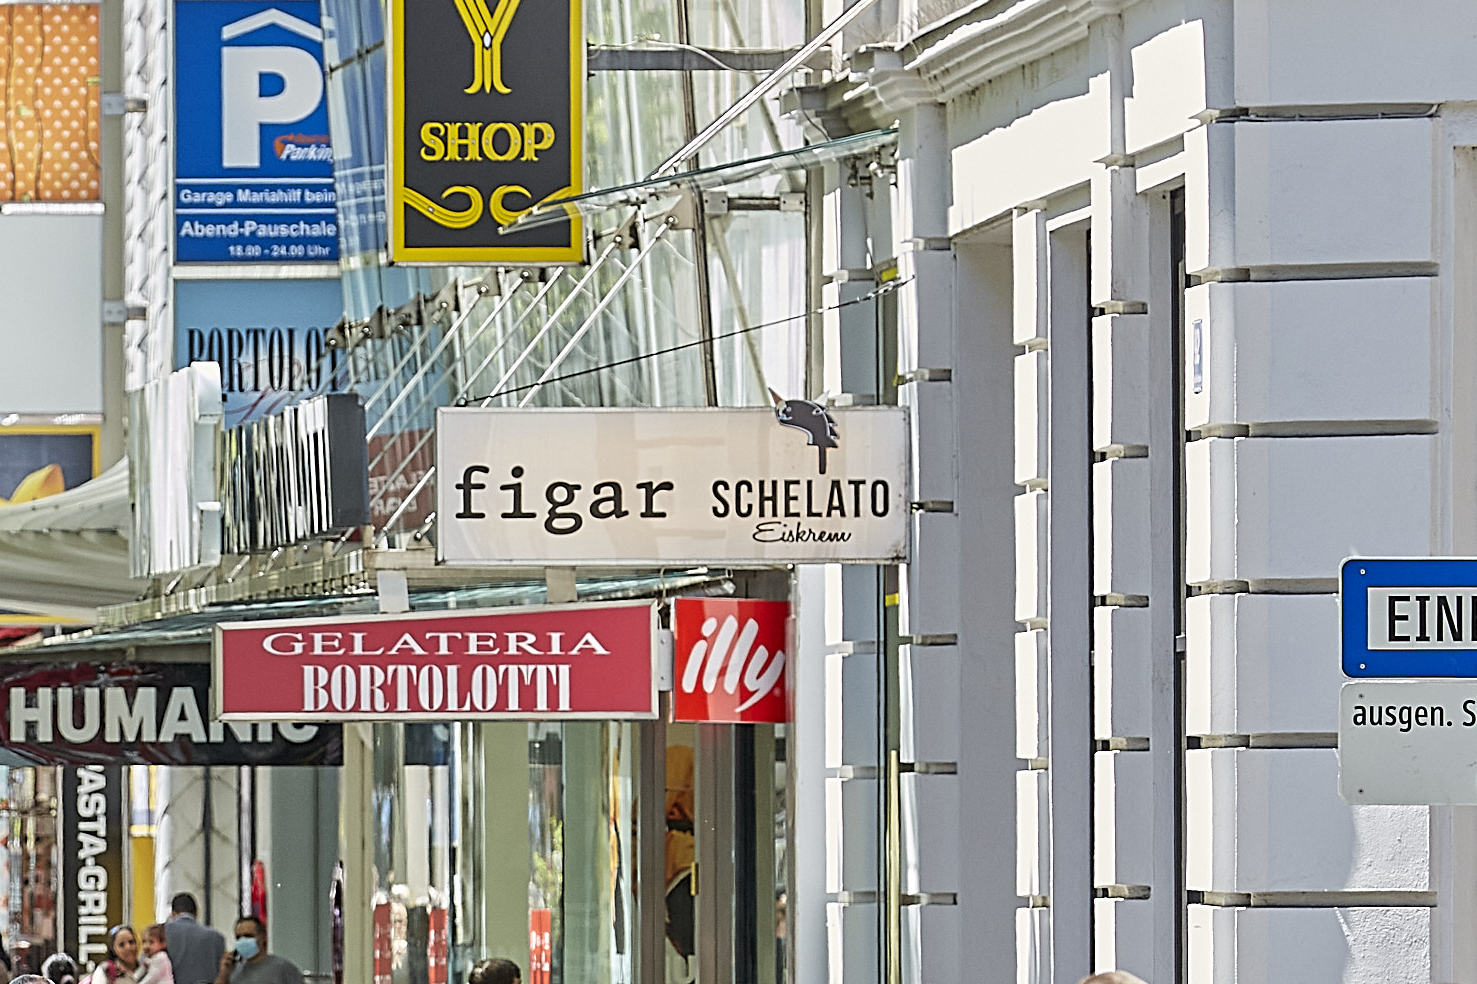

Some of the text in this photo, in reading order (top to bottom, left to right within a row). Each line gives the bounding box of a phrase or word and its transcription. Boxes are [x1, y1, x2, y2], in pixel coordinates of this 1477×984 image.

[221, 45, 323, 169] P
[280, 143, 333, 164] Parkin
[420, 121, 556, 161] SHOP
[180, 188, 234, 206] Garage
[237, 188, 302, 204] Mariahilf
[180, 220, 337, 238] Abend-Pauschale
[306, 244, 331, 257] Uhr
[455, 465, 674, 535] figar
[711, 479, 890, 518] SCHELATO
[752, 521, 852, 543] Eiskrem
[1388, 595, 1477, 642] EIN
[262, 631, 611, 656] GELATERIA
[682, 614, 785, 713] illy
[301, 664, 573, 712] BORTOLOTTI
[1353, 705, 1453, 733] ausgen.
